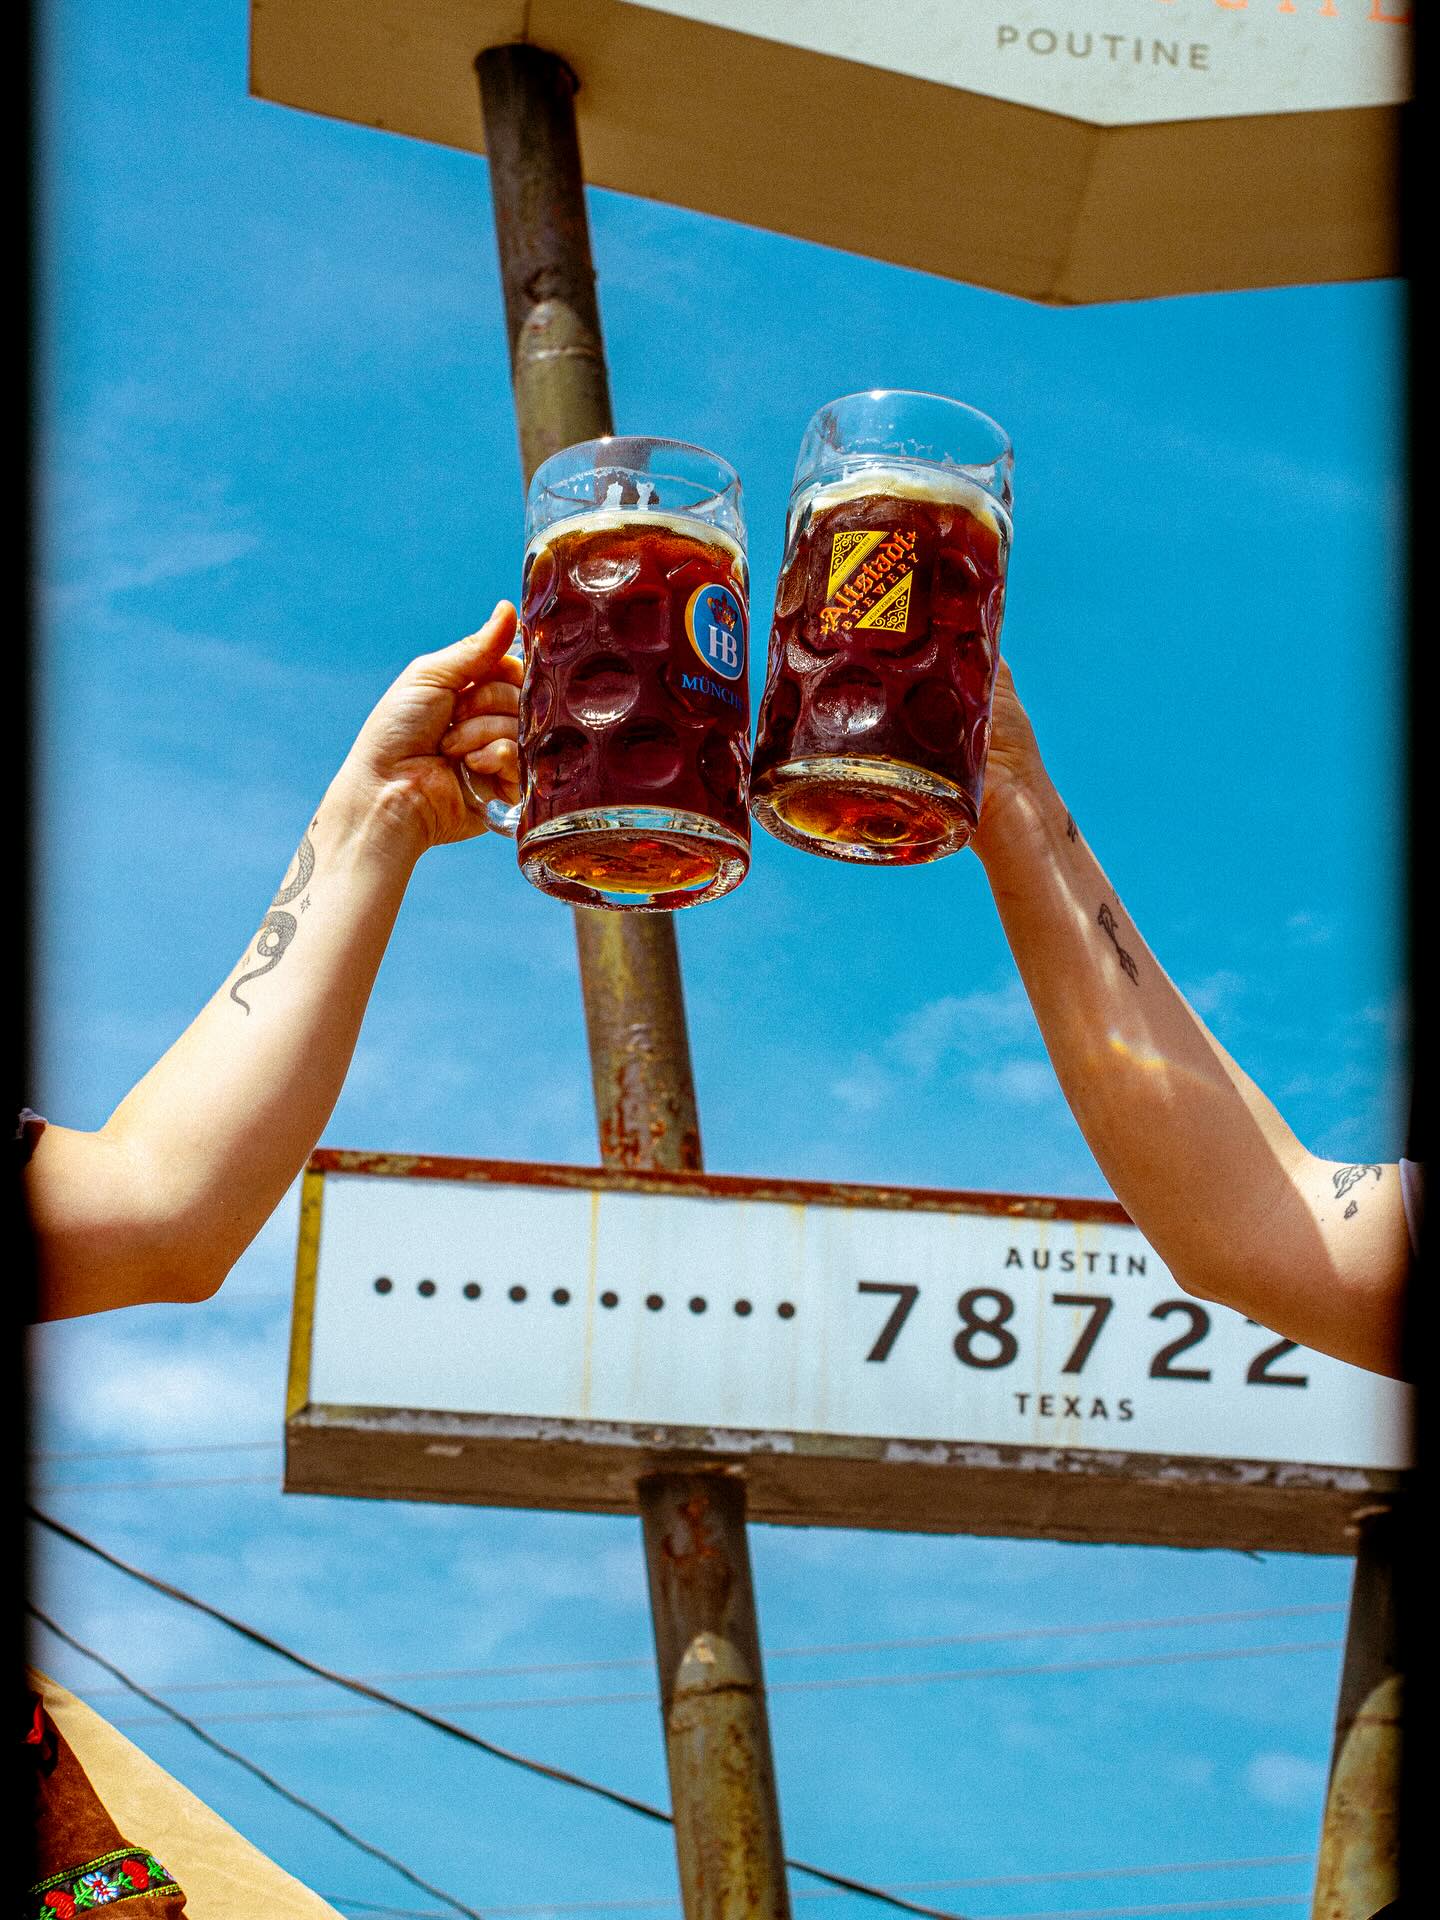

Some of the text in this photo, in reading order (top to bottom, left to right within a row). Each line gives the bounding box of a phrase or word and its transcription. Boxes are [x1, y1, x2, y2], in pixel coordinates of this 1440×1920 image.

[996, 24, 1211, 71] POUTINE
[820, 529, 915, 632] Altstadt
[841, 552, 919, 630] BREWERY
[708, 623, 738, 668] HB
[681, 672, 742, 712] MÜNCH
[1005, 1247, 1148, 1276] AUSTIN
[857, 1280, 1309, 1389] 78722
[1013, 1392, 1136, 1422] TEXAS
